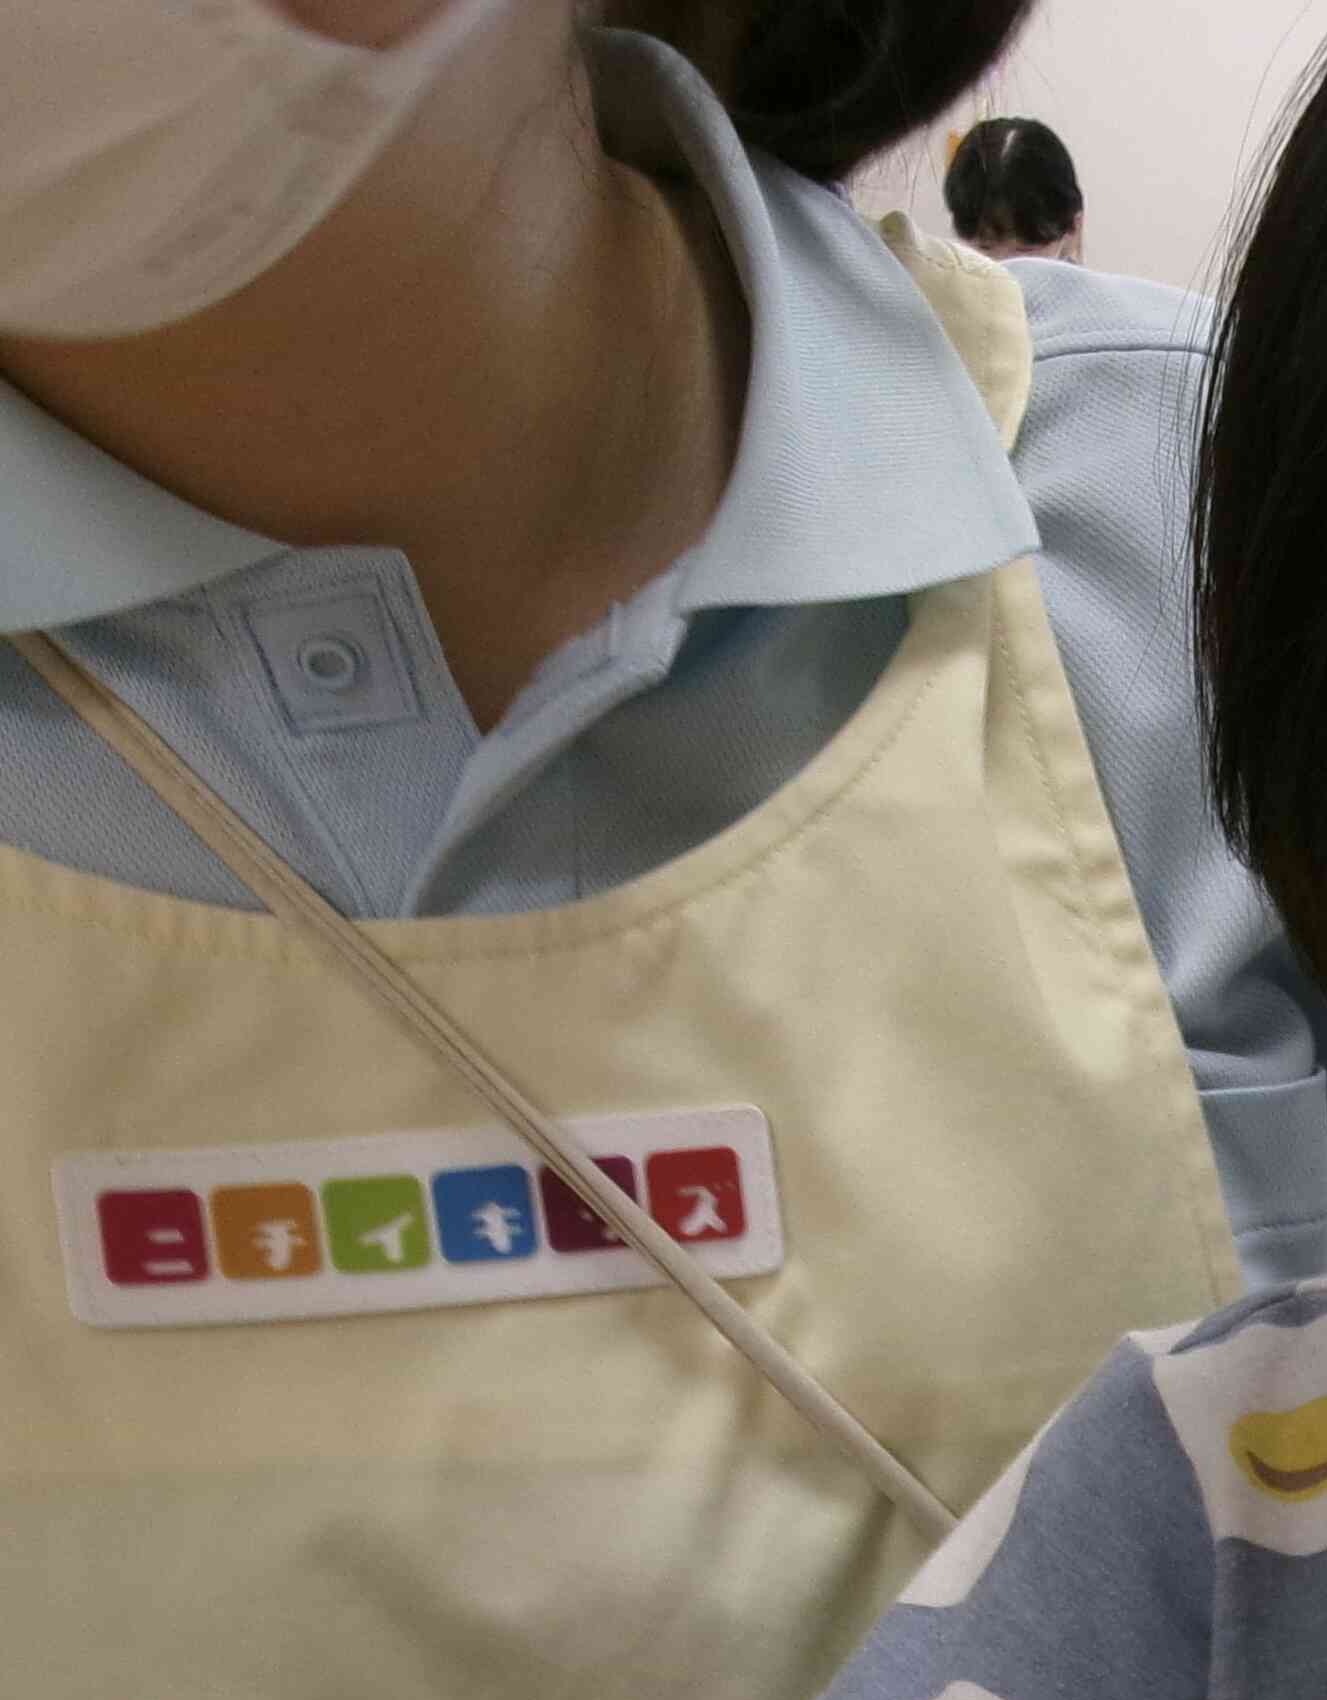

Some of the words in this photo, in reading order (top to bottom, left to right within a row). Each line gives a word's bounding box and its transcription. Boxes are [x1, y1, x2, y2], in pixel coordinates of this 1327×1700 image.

[142, 1176, 740, 1278] ニチイキズ
